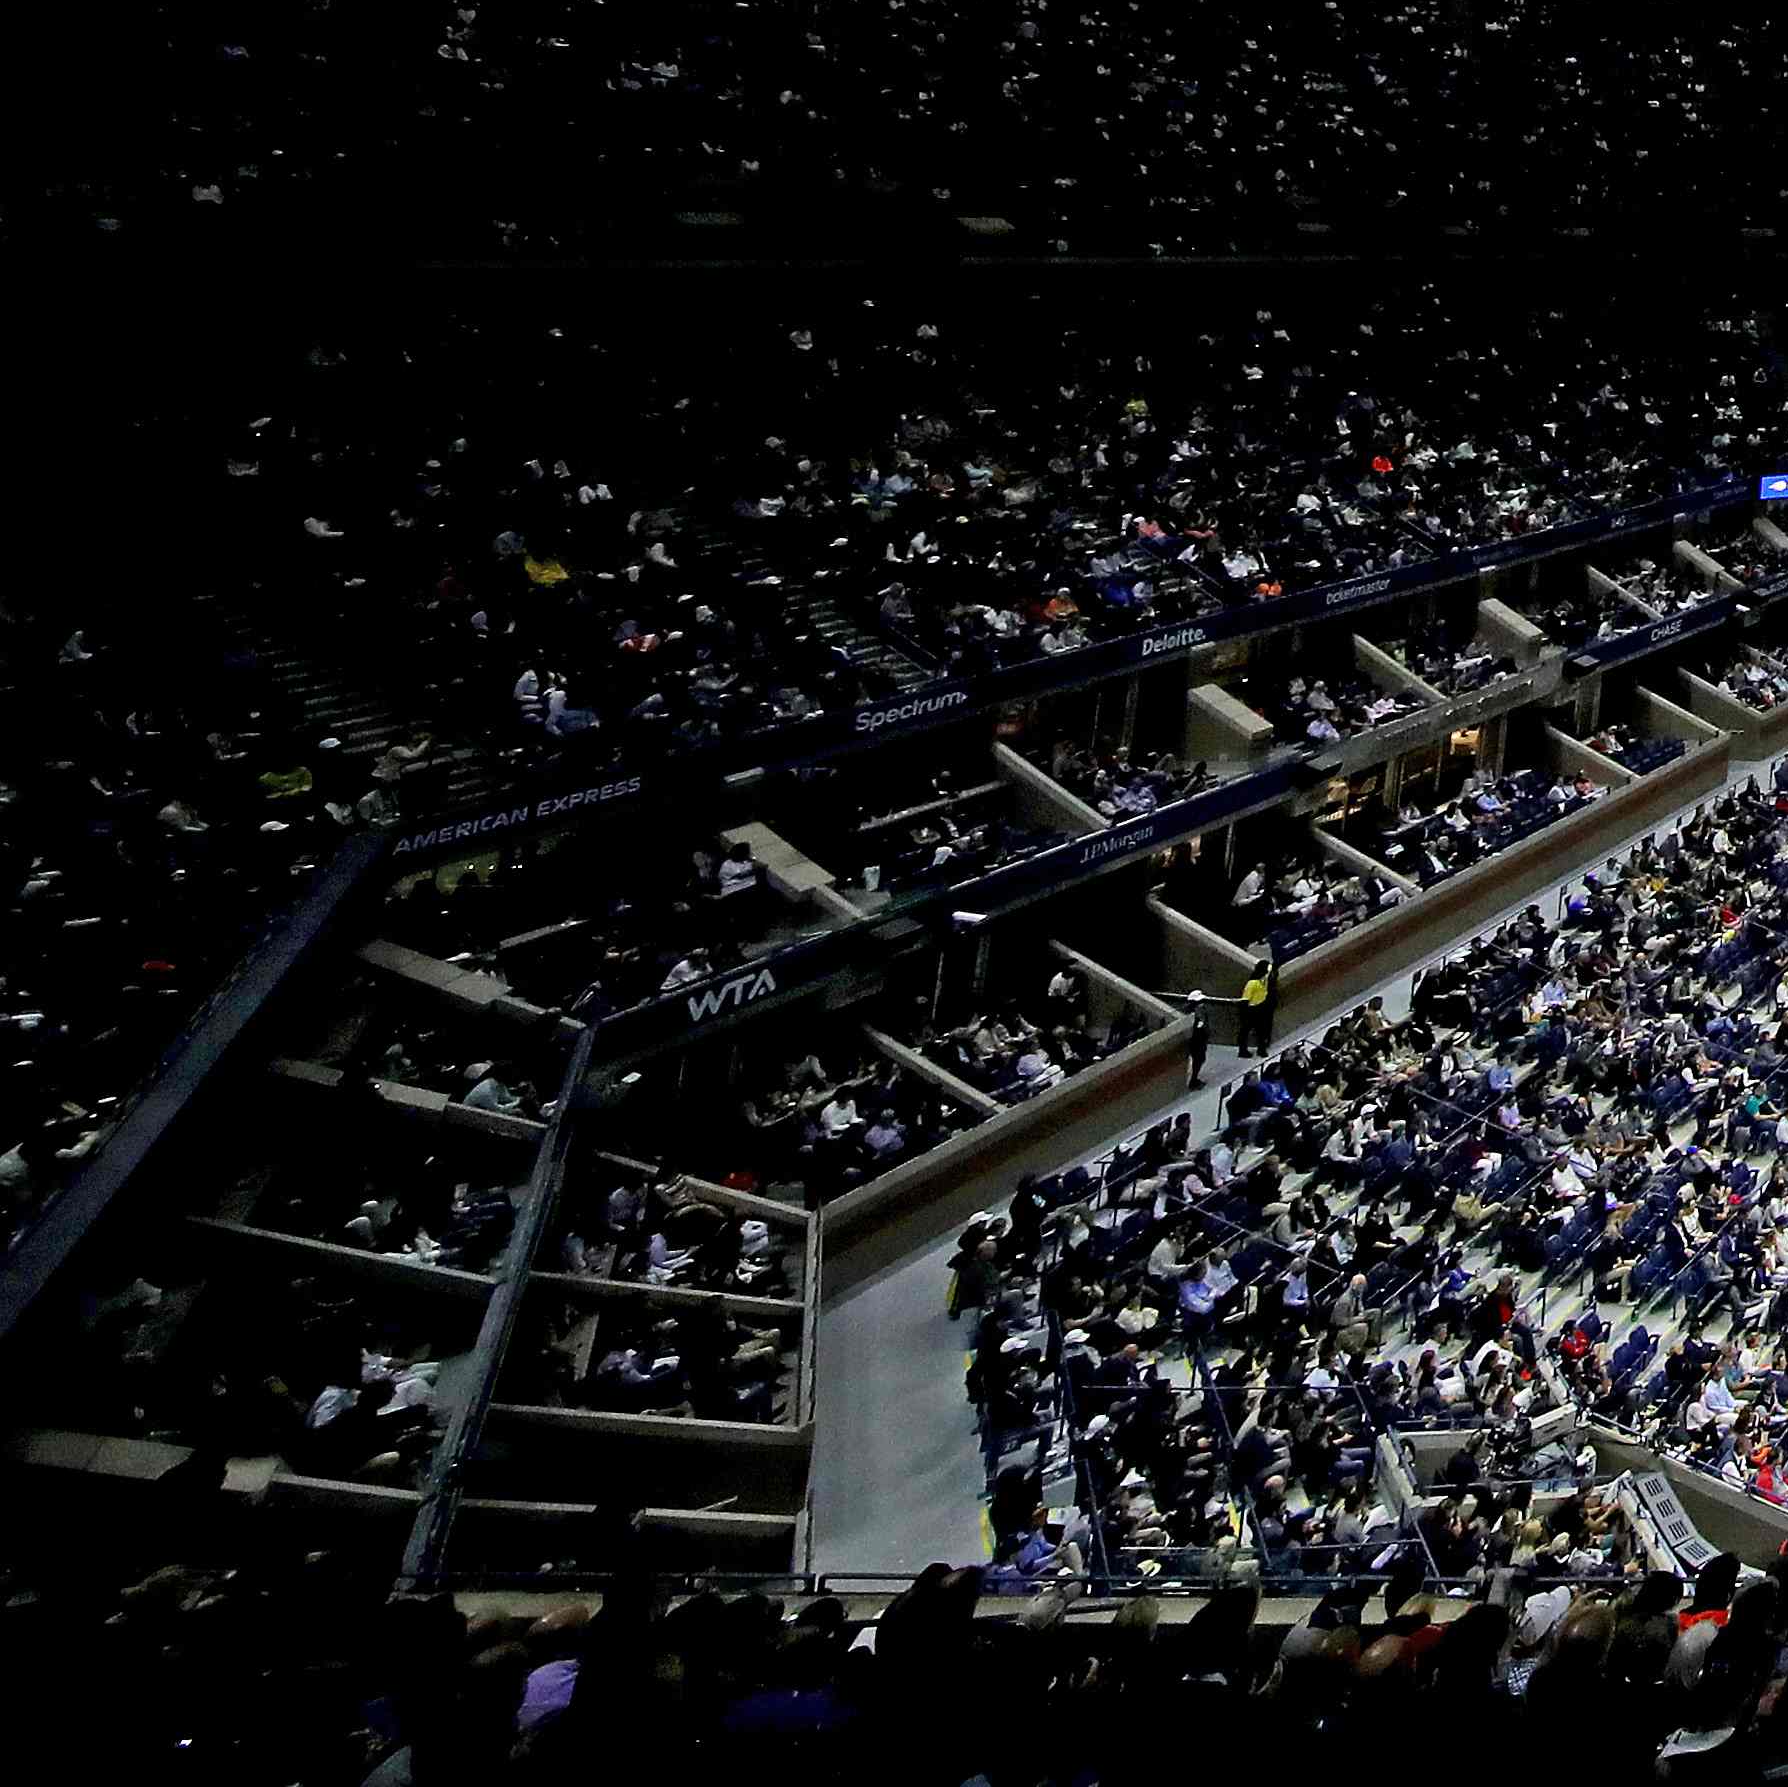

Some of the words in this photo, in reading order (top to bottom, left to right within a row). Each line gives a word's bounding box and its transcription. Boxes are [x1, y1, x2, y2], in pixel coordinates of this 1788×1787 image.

[392, 806, 529, 857] AMERICAN
[535, 775, 641, 818] EXPRESS
[687, 968, 777, 1022] WTA
